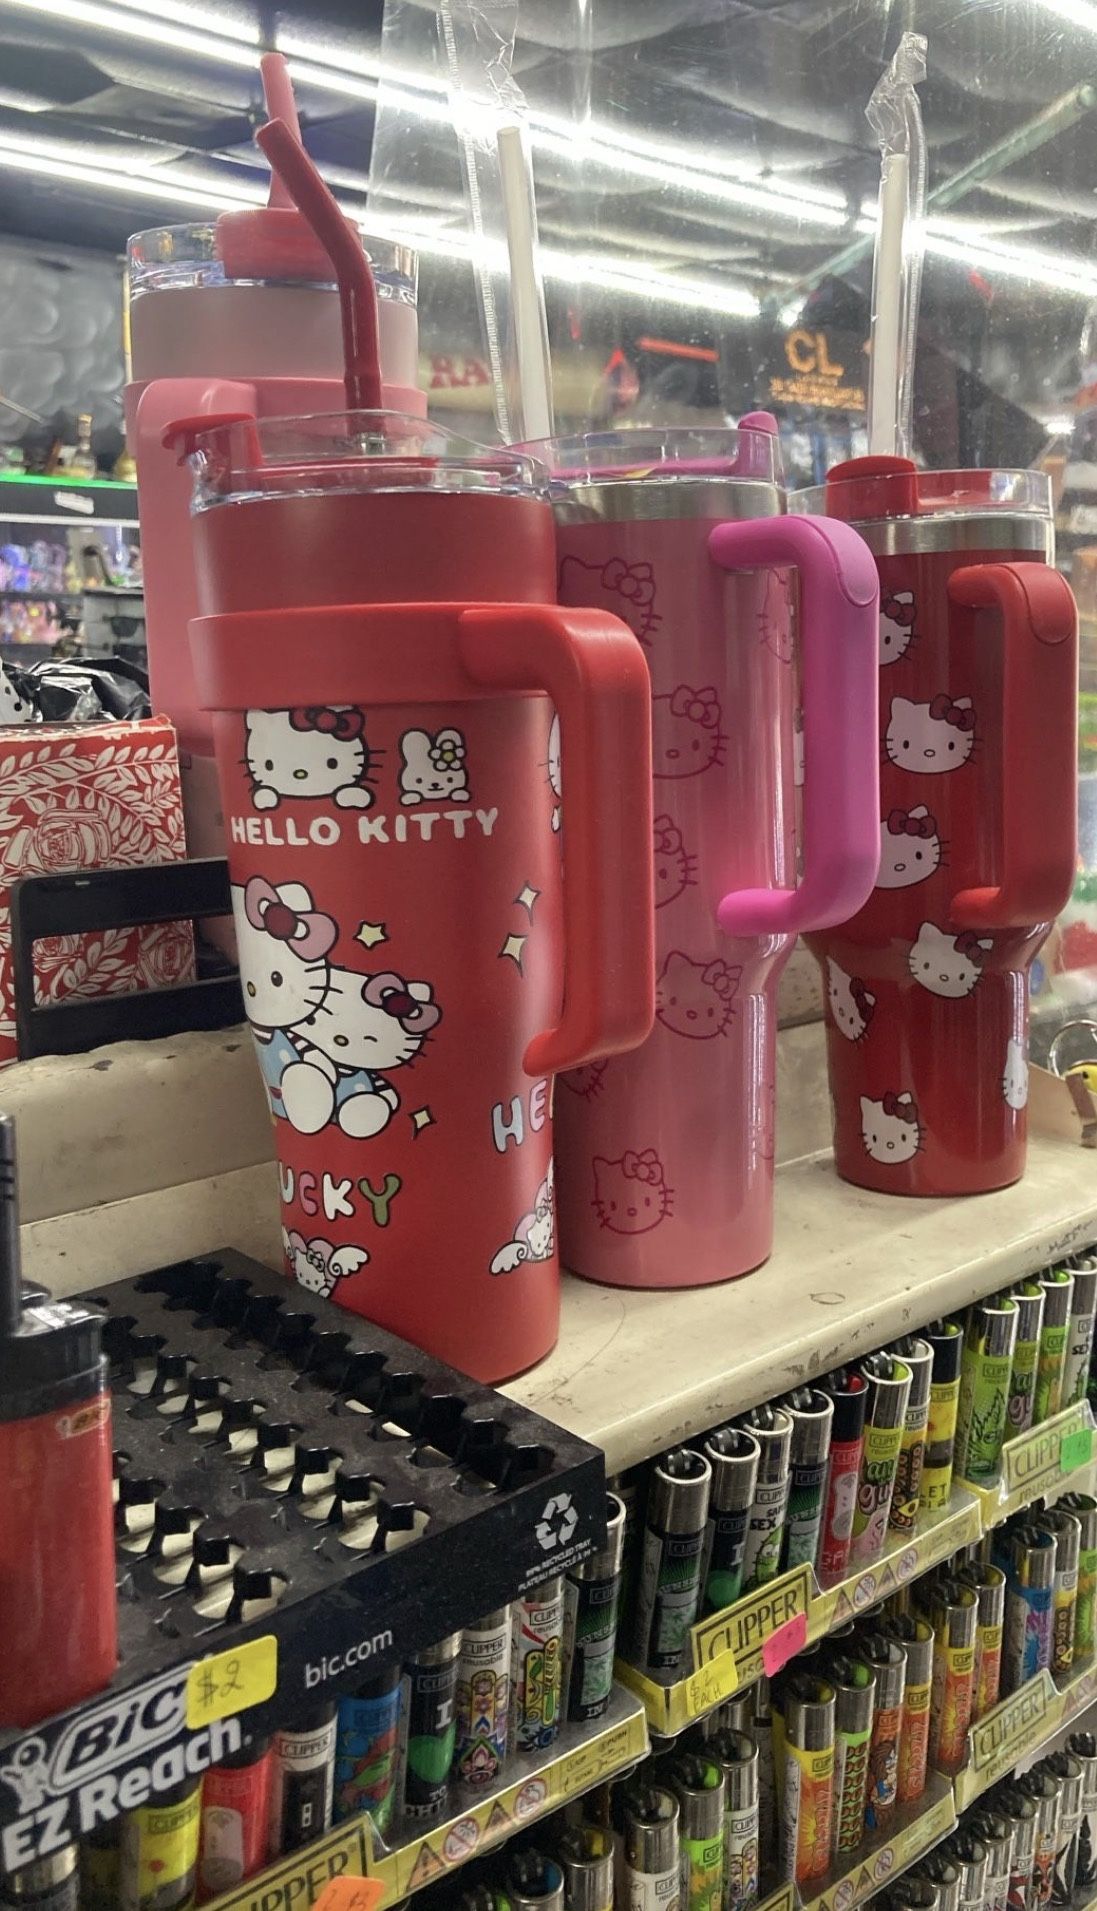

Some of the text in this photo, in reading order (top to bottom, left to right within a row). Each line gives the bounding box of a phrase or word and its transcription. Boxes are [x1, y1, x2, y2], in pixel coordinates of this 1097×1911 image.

[428, 356, 491, 389] RA
[231, 807, 498, 846] HELLO KITTY
[491, 1079, 553, 1153] HE
[279, 1162, 401, 1227] UCKY
[750, 1518, 777, 1530] SEX
[767, 1504, 784, 1518] SAF
[462, 1637, 504, 1656] CLIPPER
[708, 1588, 798, 1660] CLIPPER
[197, 1659, 244, 1708] $2
[304, 1628, 393, 1689] bic.com
[981, 1692, 1039, 1756] CLIPPER
[3, 1797, 72, 1873] EZ
[250, 1850, 349, 1911] PPER
